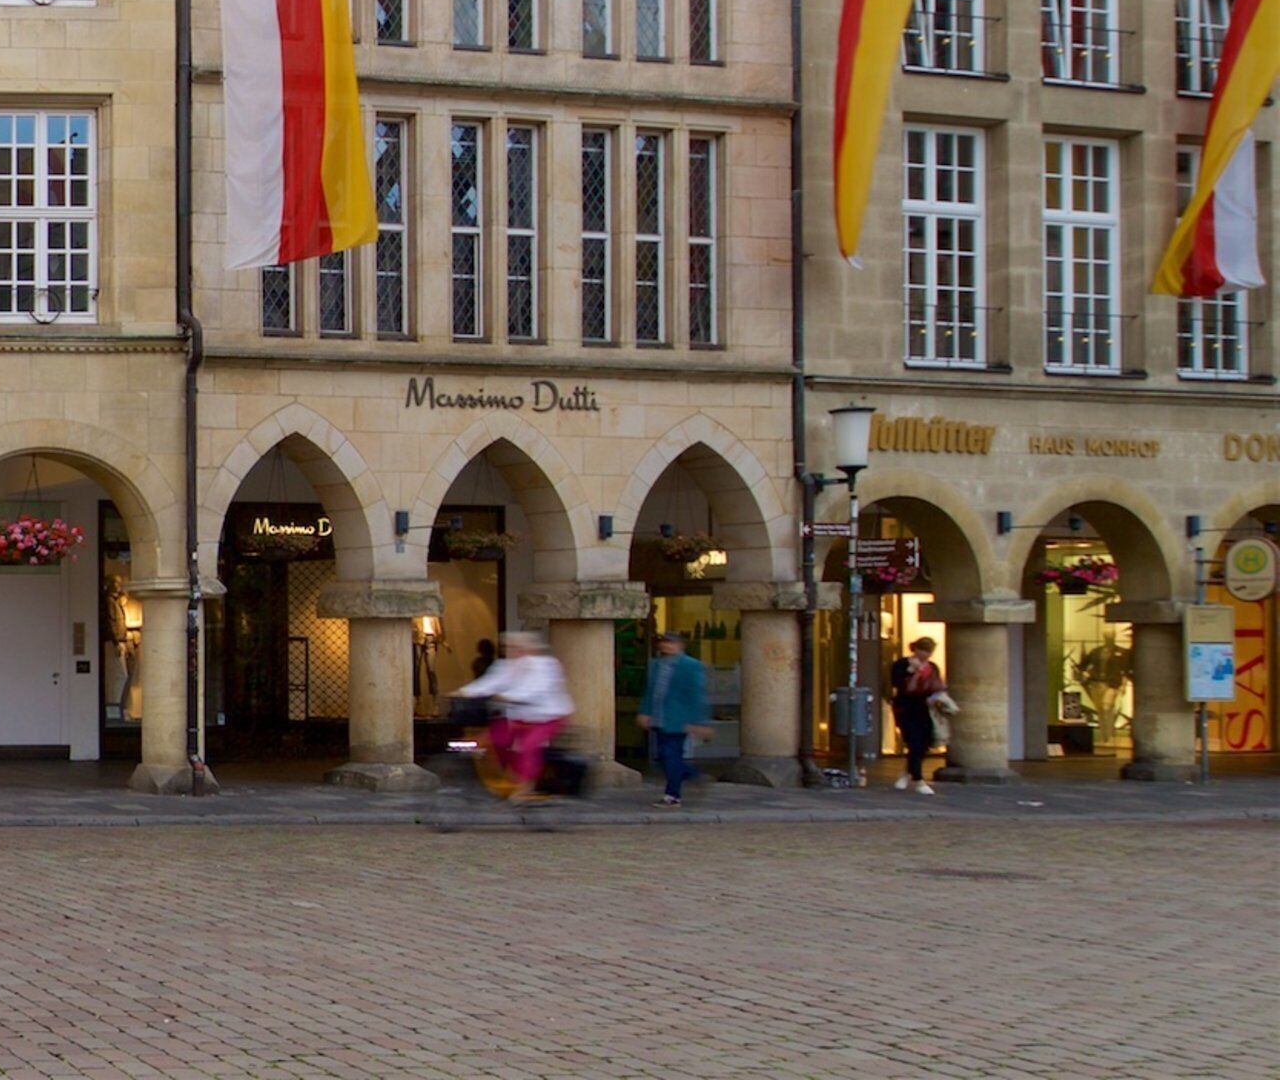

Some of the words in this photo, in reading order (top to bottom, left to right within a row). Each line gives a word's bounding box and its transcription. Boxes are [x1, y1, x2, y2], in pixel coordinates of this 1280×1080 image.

[405, 377, 524, 409] Massimo
[531, 380, 600, 412] Dutti
[1029, 436, 1076, 456] HAUS
